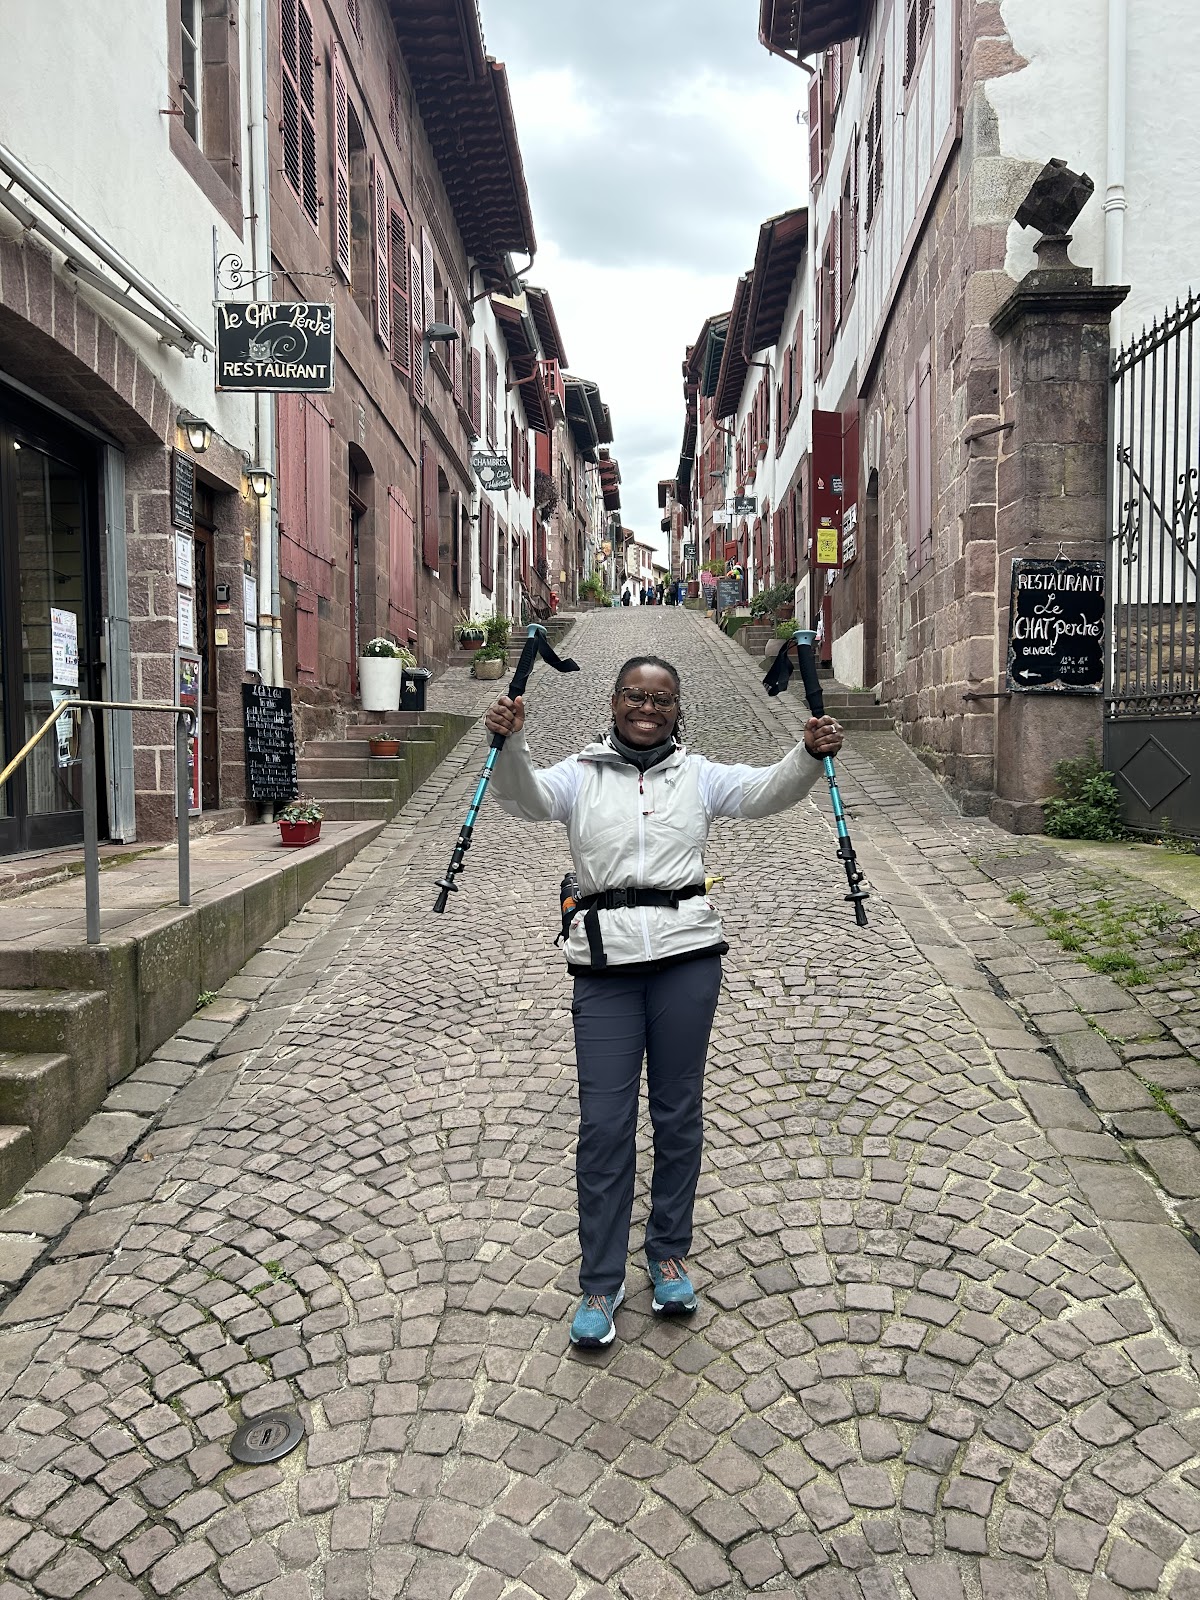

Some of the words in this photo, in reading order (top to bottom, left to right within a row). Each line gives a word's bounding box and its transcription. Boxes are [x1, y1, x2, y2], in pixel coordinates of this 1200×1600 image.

[222, 307, 243, 330] Le
[245, 304, 281, 329] CHAT
[223, 362, 327, 379] RESTAURANT
[474, 458, 505, 466] CHAMBRES
[1018, 573, 1104, 592] RESTAURANT
[1034, 593, 1064, 615] Le
[1015, 616, 1055, 640] CHAT
[1023, 640, 1056, 656] ouvert
